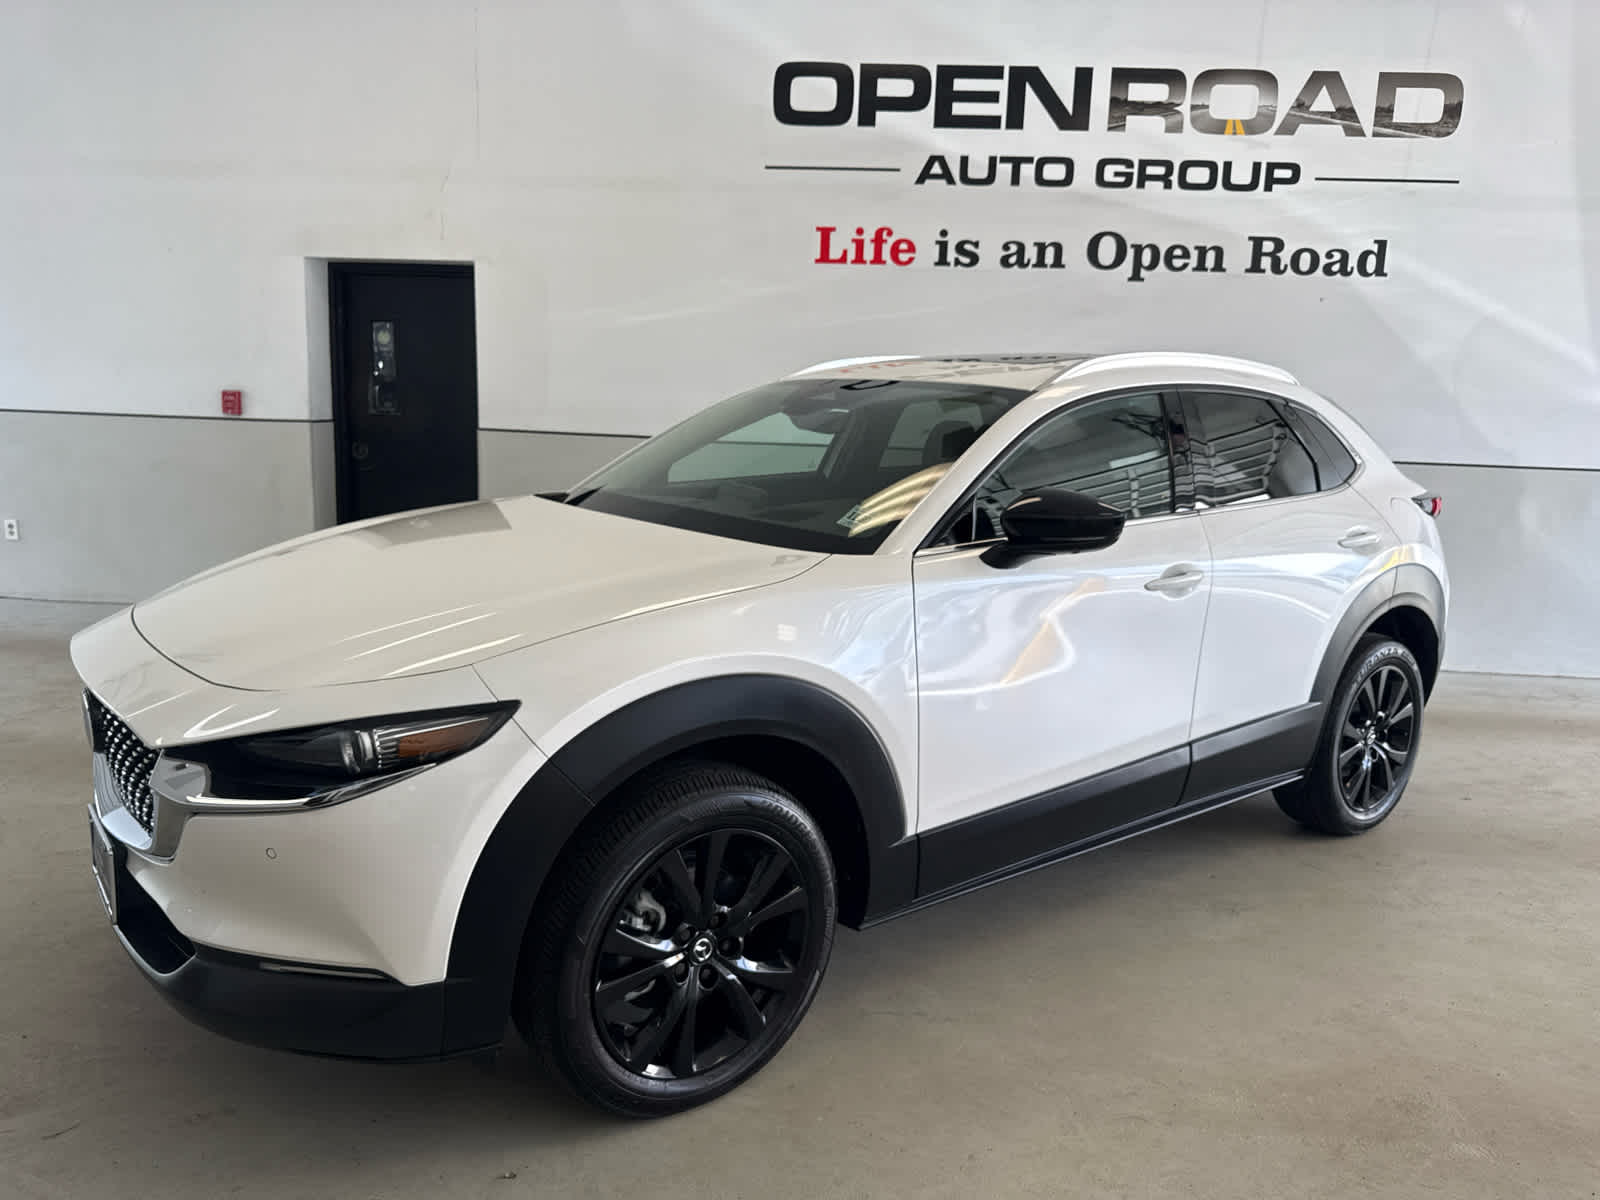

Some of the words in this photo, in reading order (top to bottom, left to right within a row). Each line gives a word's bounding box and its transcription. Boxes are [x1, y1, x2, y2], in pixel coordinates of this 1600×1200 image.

[773, 62, 1094, 131] OPEN
[1107, 67, 1464, 138] ROAD
[914, 155, 1074, 187] AUTO
[1096, 158, 1301, 192] GROUP
[815, 227, 916, 266] Life
[934, 229, 979, 268] is
[1000, 241, 1065, 269] an
[1087, 231, 1226, 282] Open
[1245, 236, 1388, 277] Road
